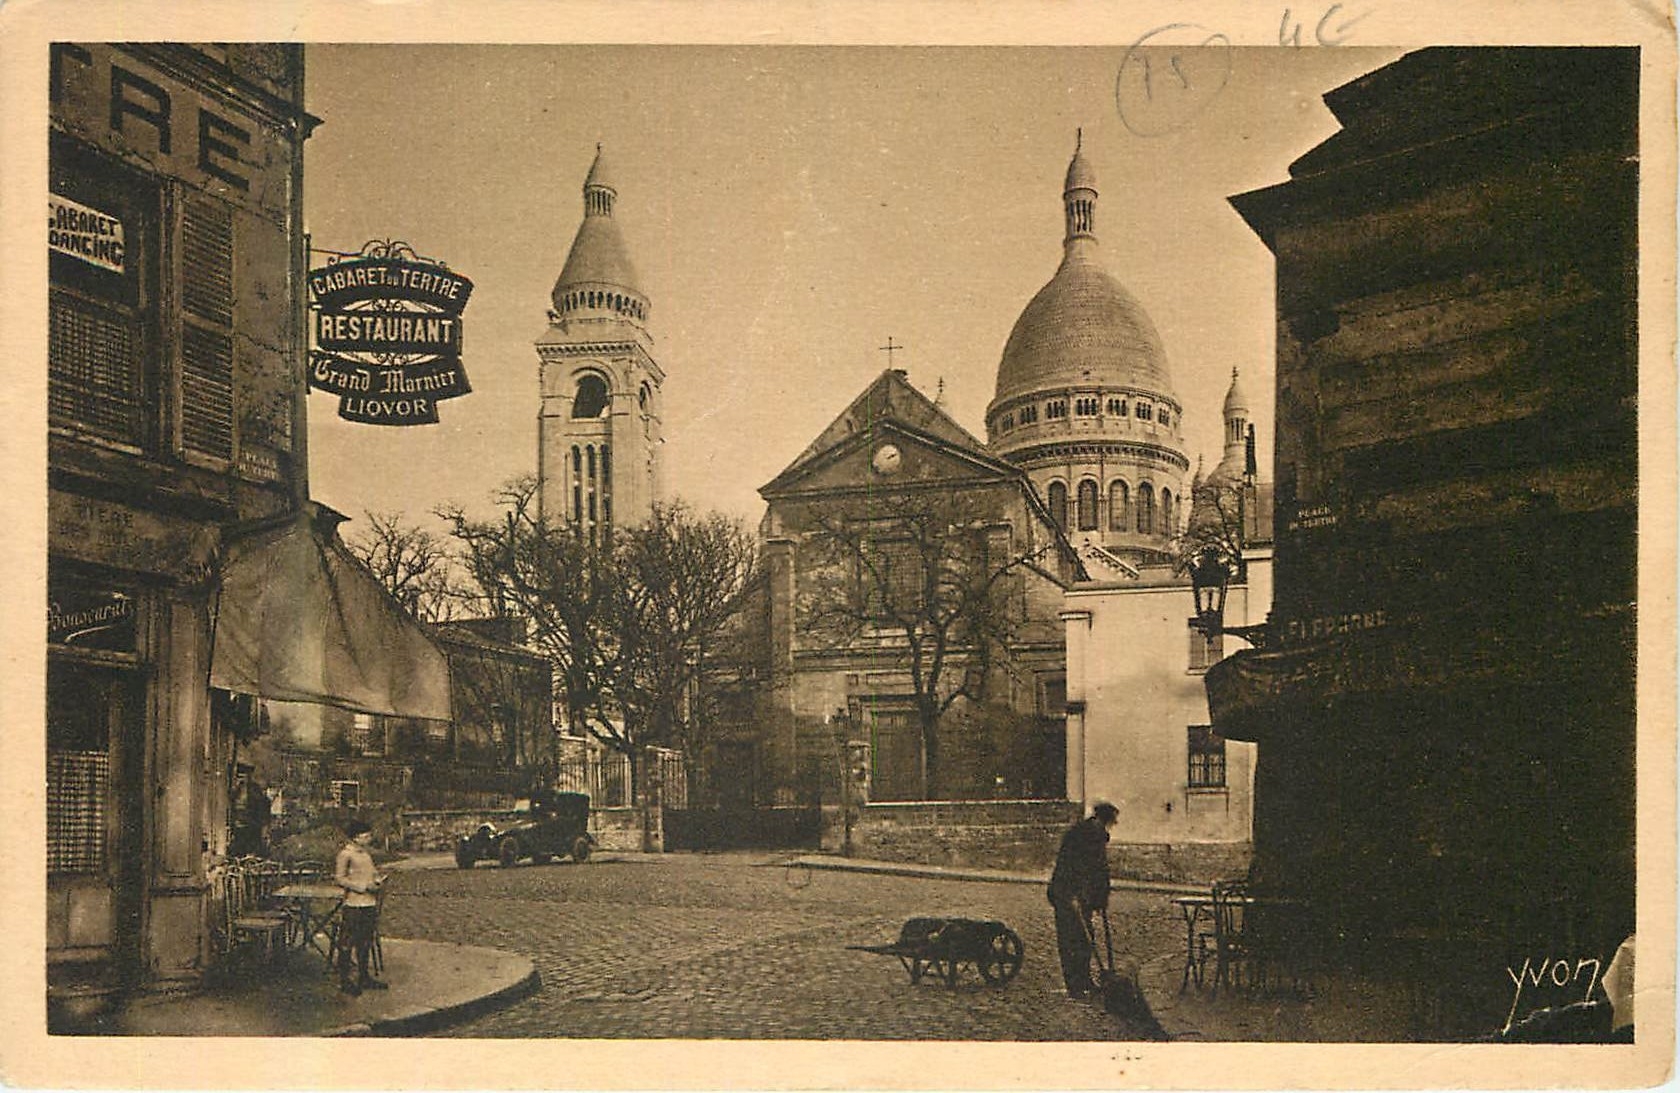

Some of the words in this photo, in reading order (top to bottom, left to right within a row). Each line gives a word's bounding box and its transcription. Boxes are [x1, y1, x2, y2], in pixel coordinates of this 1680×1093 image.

[313, 267, 387, 295] CABARET
[401, 268, 463, 300] TERTRE
[320, 315, 453, 344] RESTAURANT
[314, 358, 372, 391] Grand
[379, 369, 457, 394] Marnier
